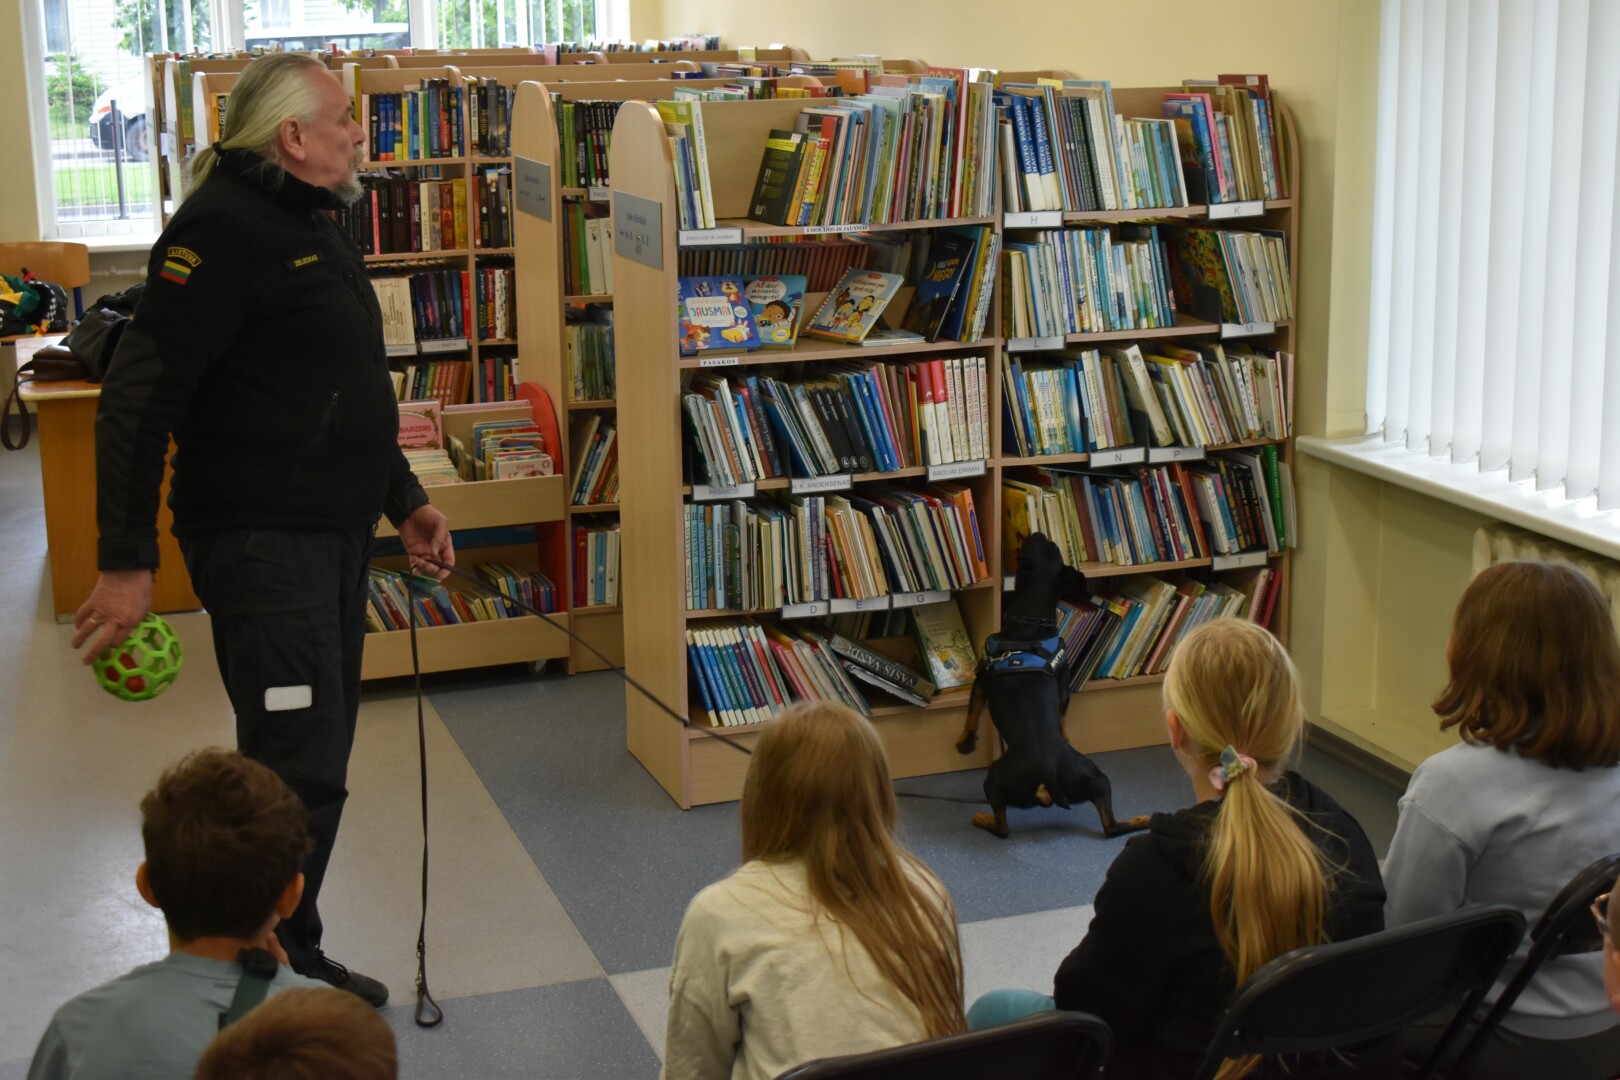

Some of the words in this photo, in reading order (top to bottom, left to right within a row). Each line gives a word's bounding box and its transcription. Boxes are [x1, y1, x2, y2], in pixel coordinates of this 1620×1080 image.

[1016, 104, 1026, 141] PASAKOS
[1234, 206, 1240, 214] K
[1030, 216, 1037, 224] H
[171, 248, 197, 263] LIETUVA
[690, 306, 732, 317] JAUSMAI
[1115, 454, 1122, 462] N
[933, 469, 956, 477] BROLIAI
[958, 466, 980, 474] GRIMAI
[857, 601, 862, 609] E
[810, 606, 817, 614] D
